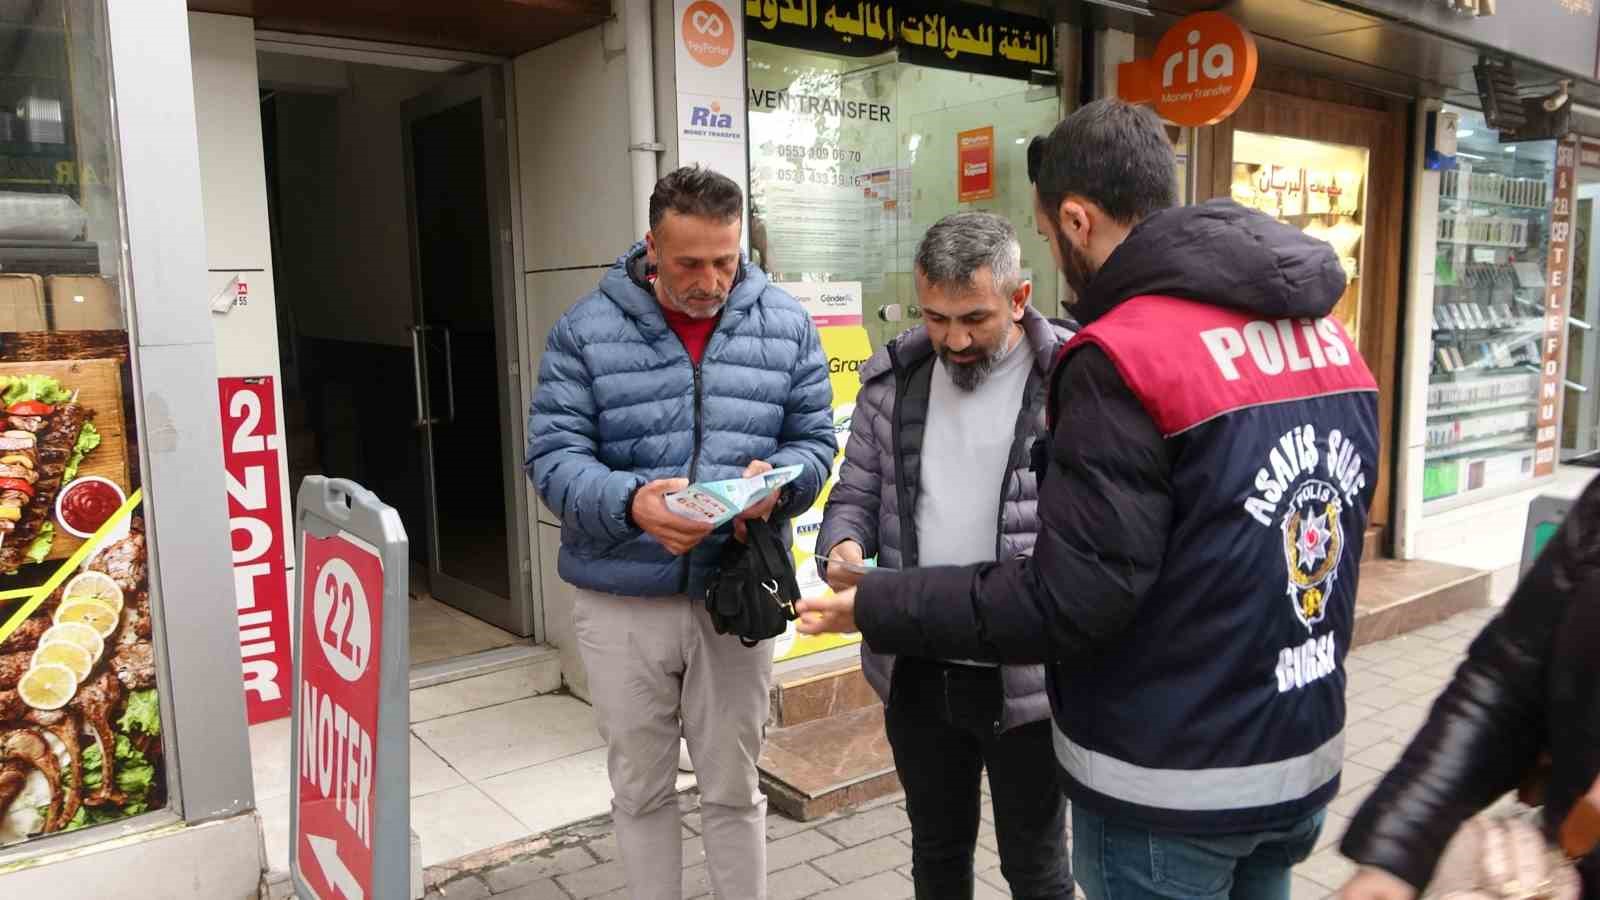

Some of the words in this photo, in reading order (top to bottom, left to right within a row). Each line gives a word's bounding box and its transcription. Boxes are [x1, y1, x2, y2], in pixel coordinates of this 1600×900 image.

[901, 13, 993, 58] للحوالات
[999, 26, 1048, 65] الثقة
[1162, 30, 1234, 87] ria
[691, 100, 732, 128] Ria
[796, 94, 890, 122] TRANSFER
[1162, 92, 1193, 103] Money
[1195, 84, 1233, 97] Transfer
[848, 150, 861, 163] 70
[1200, 318, 1350, 380] POLİS
[1244, 424, 1320, 527] ASAYİŞ
[224, 465, 283, 702] NOTER
[323, 573, 362, 669] 22.
[303, 680, 372, 849] NOTER
